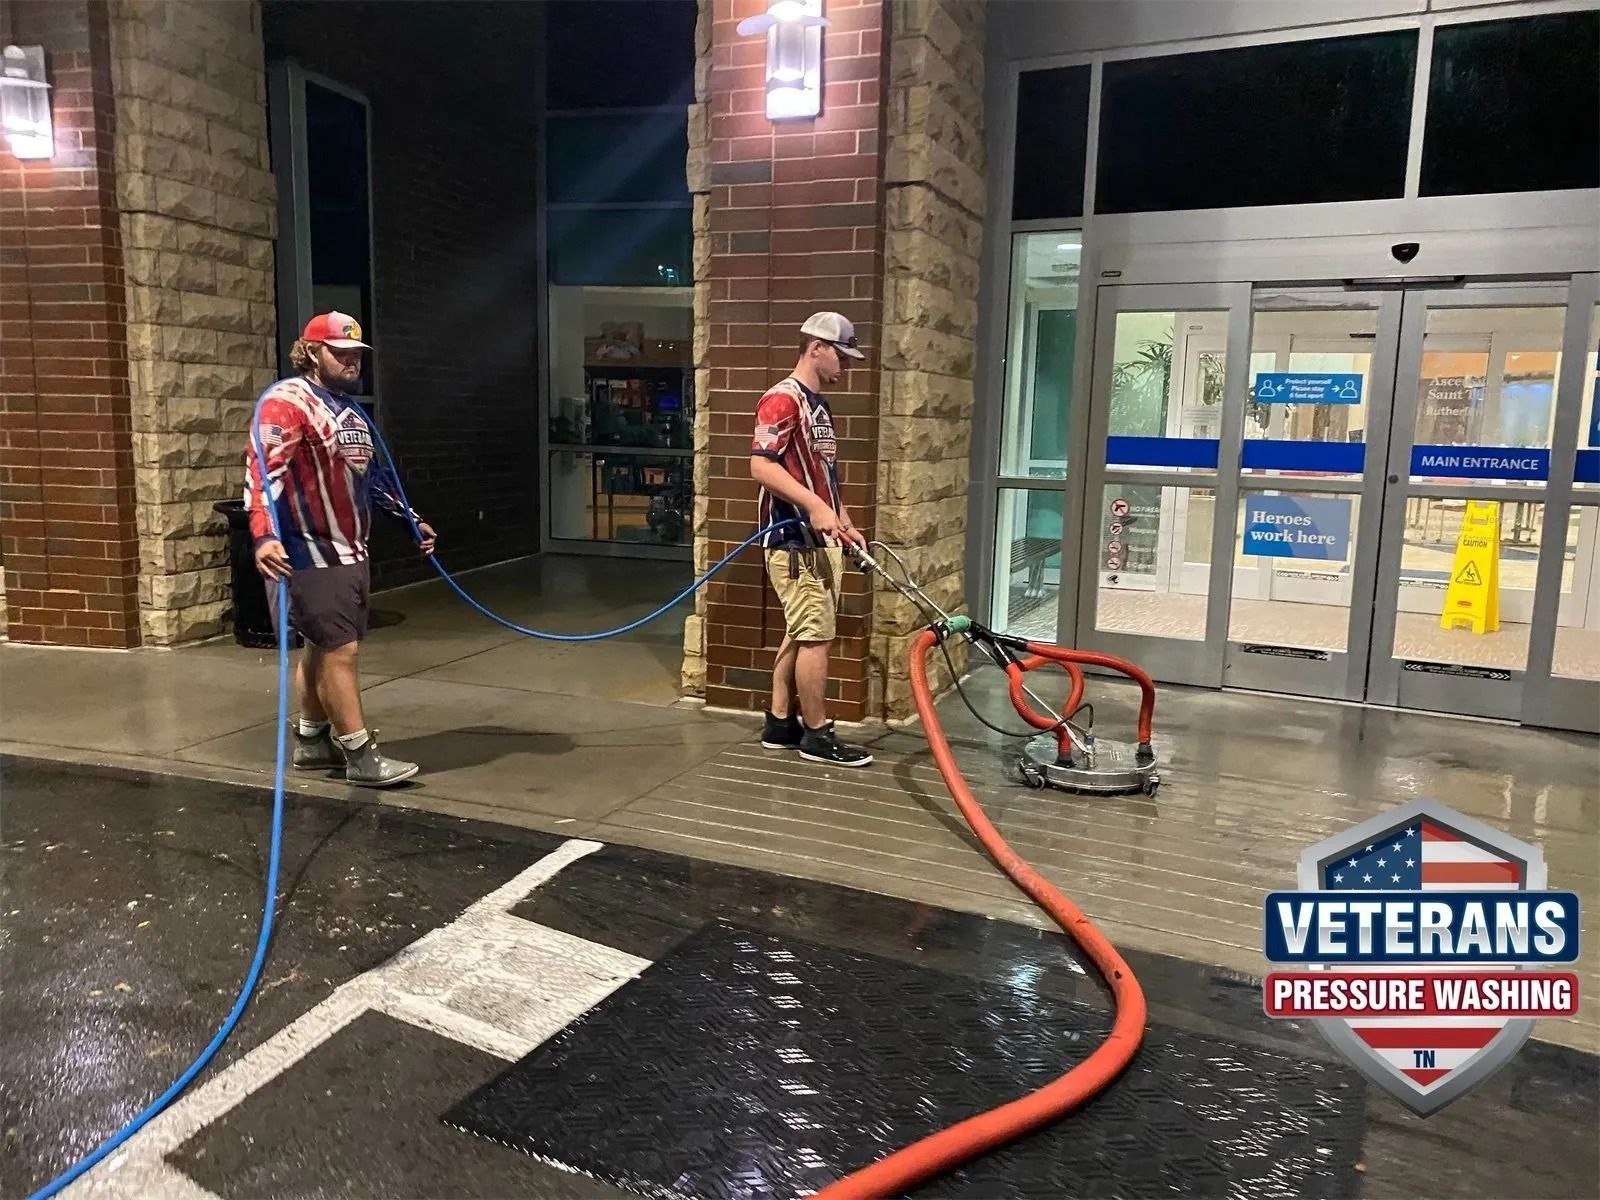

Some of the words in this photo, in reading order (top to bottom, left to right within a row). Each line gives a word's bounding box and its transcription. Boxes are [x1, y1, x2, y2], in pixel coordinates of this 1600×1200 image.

[1427, 388, 1464, 401] Saint
[1421, 455, 1460, 468] MAIN
[1462, 457, 1539, 470] ENTRANCE
[1251, 510, 1312, 526] Heroes
[1250, 529, 1294, 543] work
[1297, 530, 1336, 545] here
[1463, 539, 1488, 548] CAUTION
